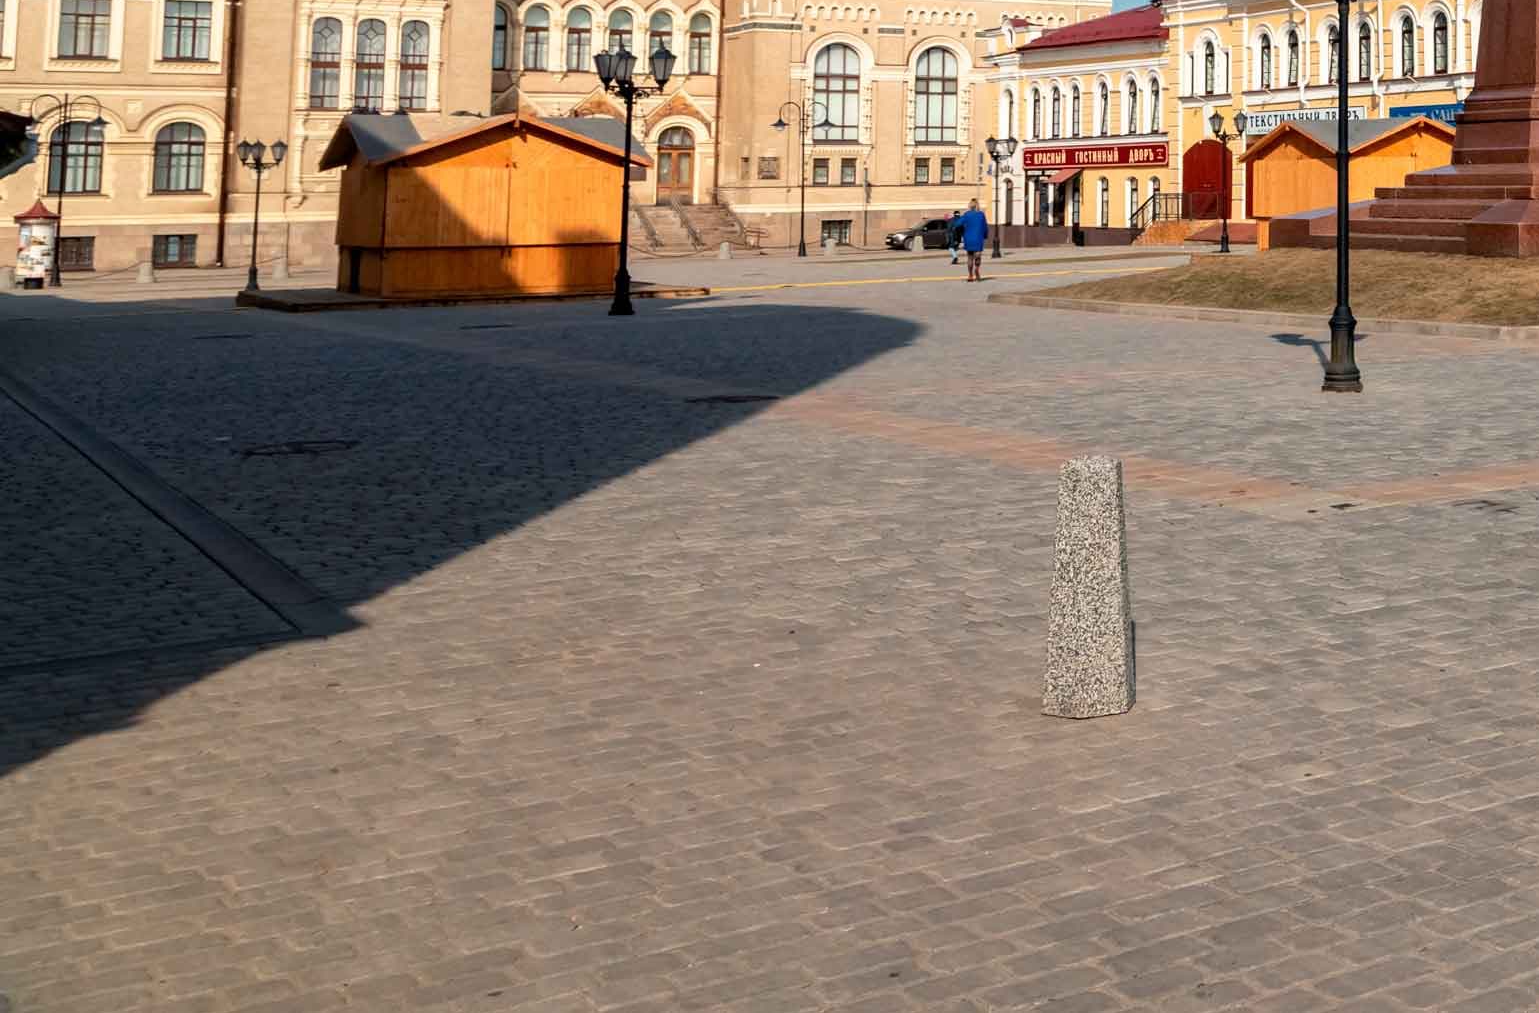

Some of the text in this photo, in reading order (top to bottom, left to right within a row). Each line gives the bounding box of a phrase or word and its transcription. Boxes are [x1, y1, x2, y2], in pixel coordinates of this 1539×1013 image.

[1034, 147, 1154, 165] КРАСНЫЙ ГОСТИННЫЙ ДВОРЪ
